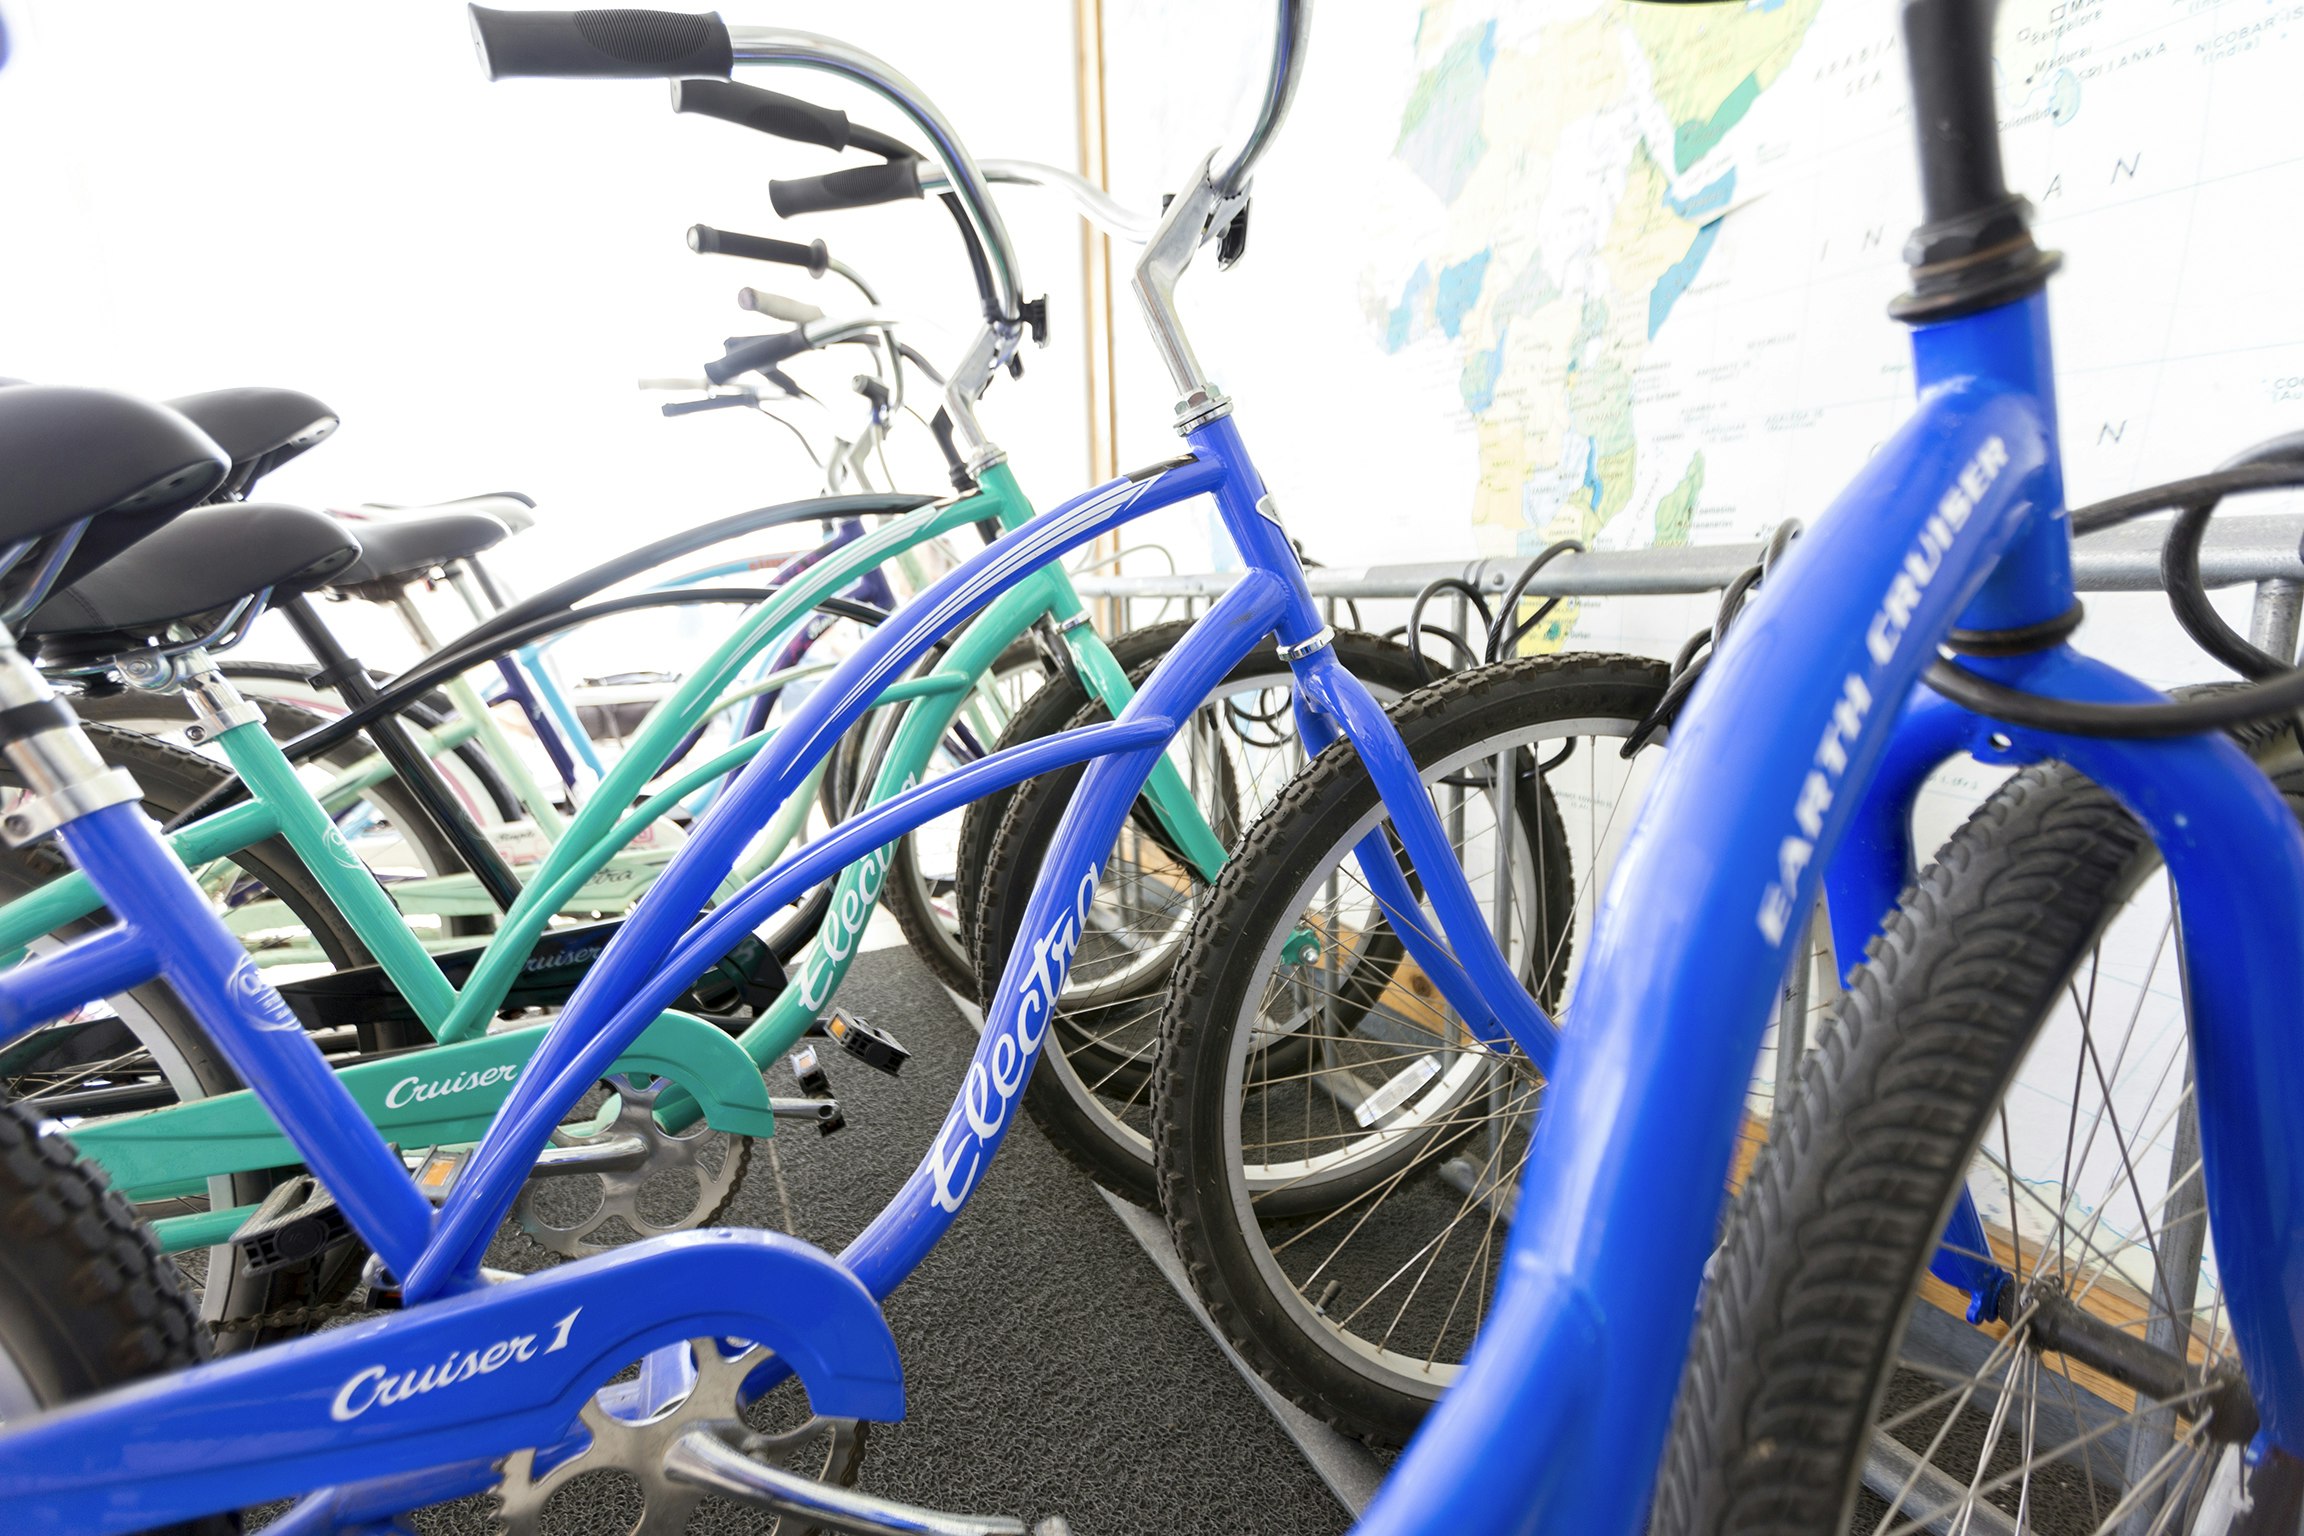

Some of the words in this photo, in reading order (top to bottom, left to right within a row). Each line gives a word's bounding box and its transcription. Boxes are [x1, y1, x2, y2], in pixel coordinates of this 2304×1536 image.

[2193, 14, 2278, 56] NICOBAR
[1759, 674, 1870, 945] EARTH
[1867, 434, 2009, 665] CRUISER
[524, 945, 602, 972] ruiser
[925, 862, 1101, 1214] Electra
[385, 1064, 518, 1110] Cruiser
[330, 1333, 538, 1422] Cruiser
[543, 1306, 583, 1355] 1
